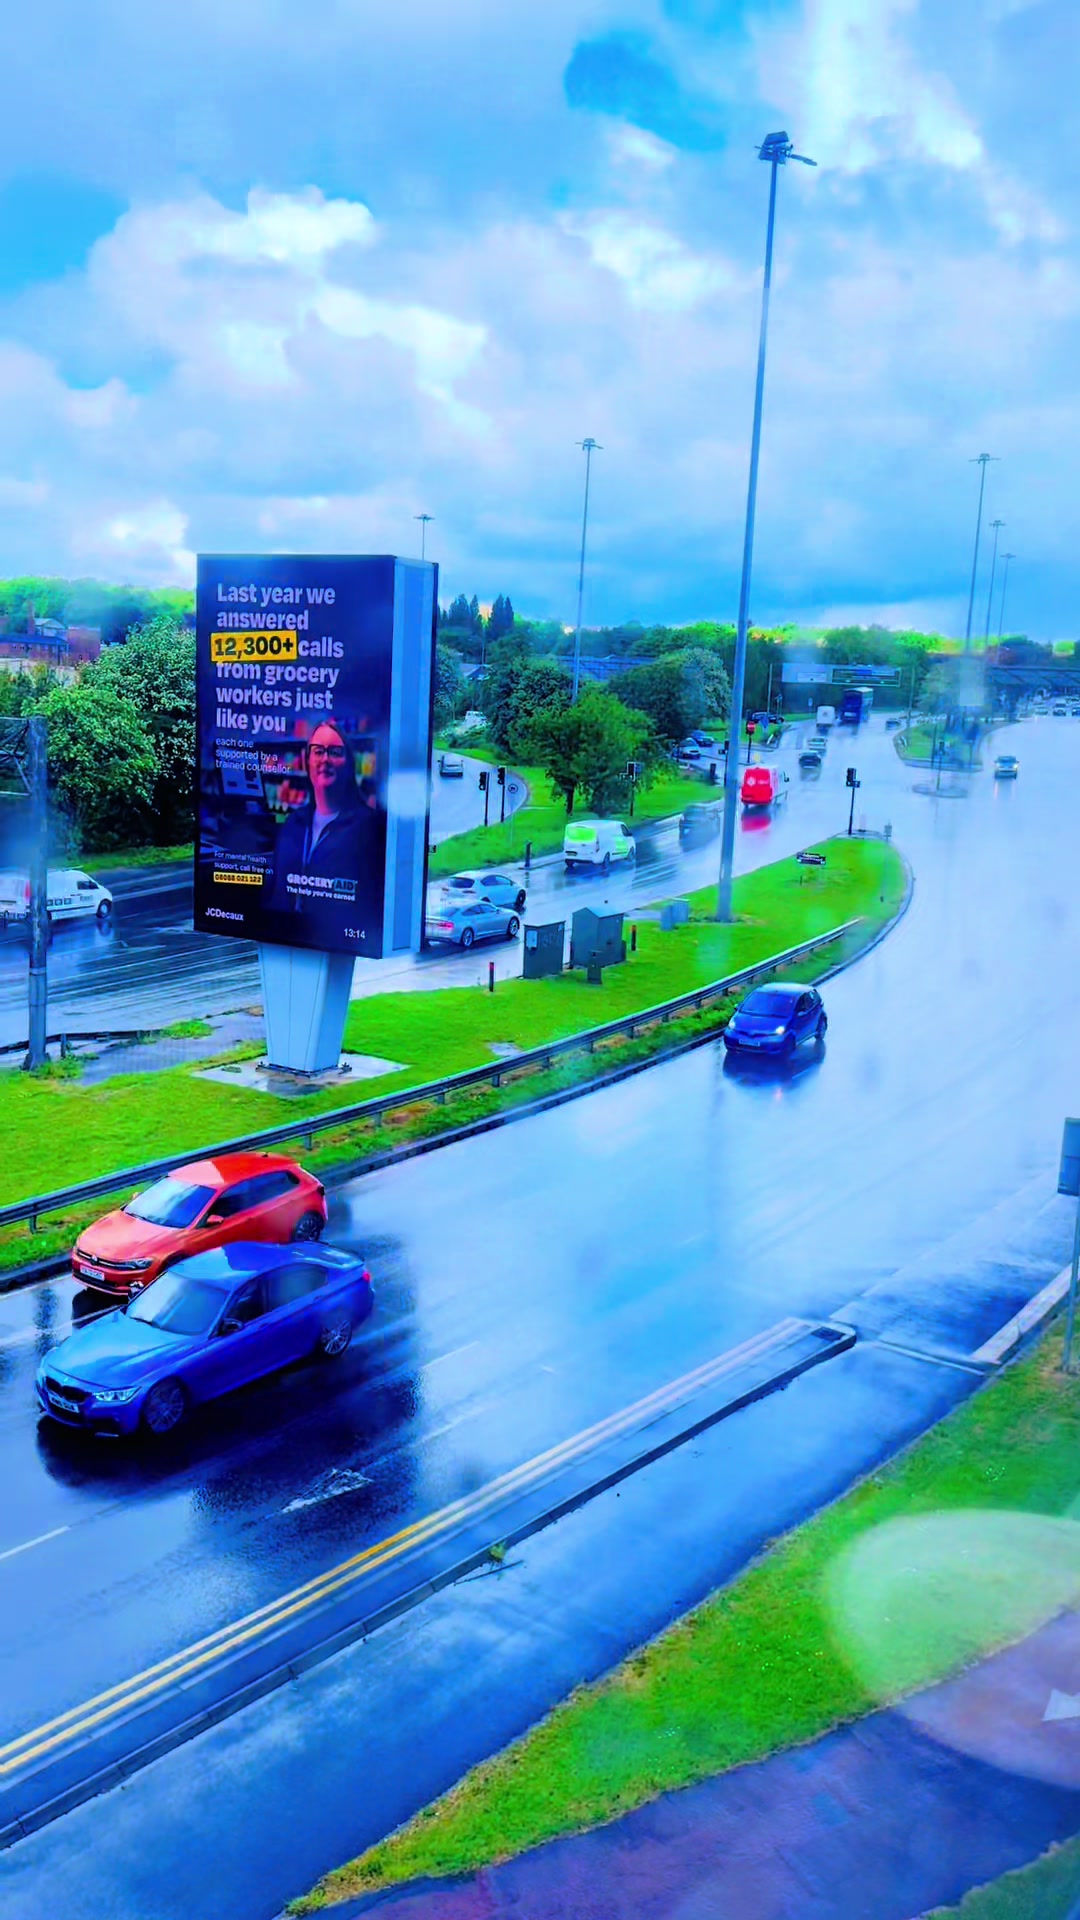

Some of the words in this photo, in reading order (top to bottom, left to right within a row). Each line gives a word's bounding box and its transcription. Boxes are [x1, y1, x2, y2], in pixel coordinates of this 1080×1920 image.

[217, 583, 257, 603] Last
[260, 587, 303, 607] year
[306, 587, 336, 605] we
[217, 609, 309, 630] answered
[214, 635, 294, 659] 12,300+
[298, 636, 344, 658] calls
[216, 661, 261, 679] from
[264, 664, 340, 688] grocery
[216, 685, 292, 707] workers
[295, 687, 333, 712] just
[216, 708, 248, 729] like
[252, 713, 286, 734] you
[215, 737, 236, 747] each
[237, 739, 254, 748] one
[215, 749, 258, 760] supported
[260, 751, 274, 763] by
[215, 759, 245, 770] trained
[246, 761, 290, 774] counsellor
[286, 886, 298, 894] The
[333, 892, 356, 901] earned
[205, 907, 244, 921] JCDecaux
[344, 928, 366, 939] 13:14
